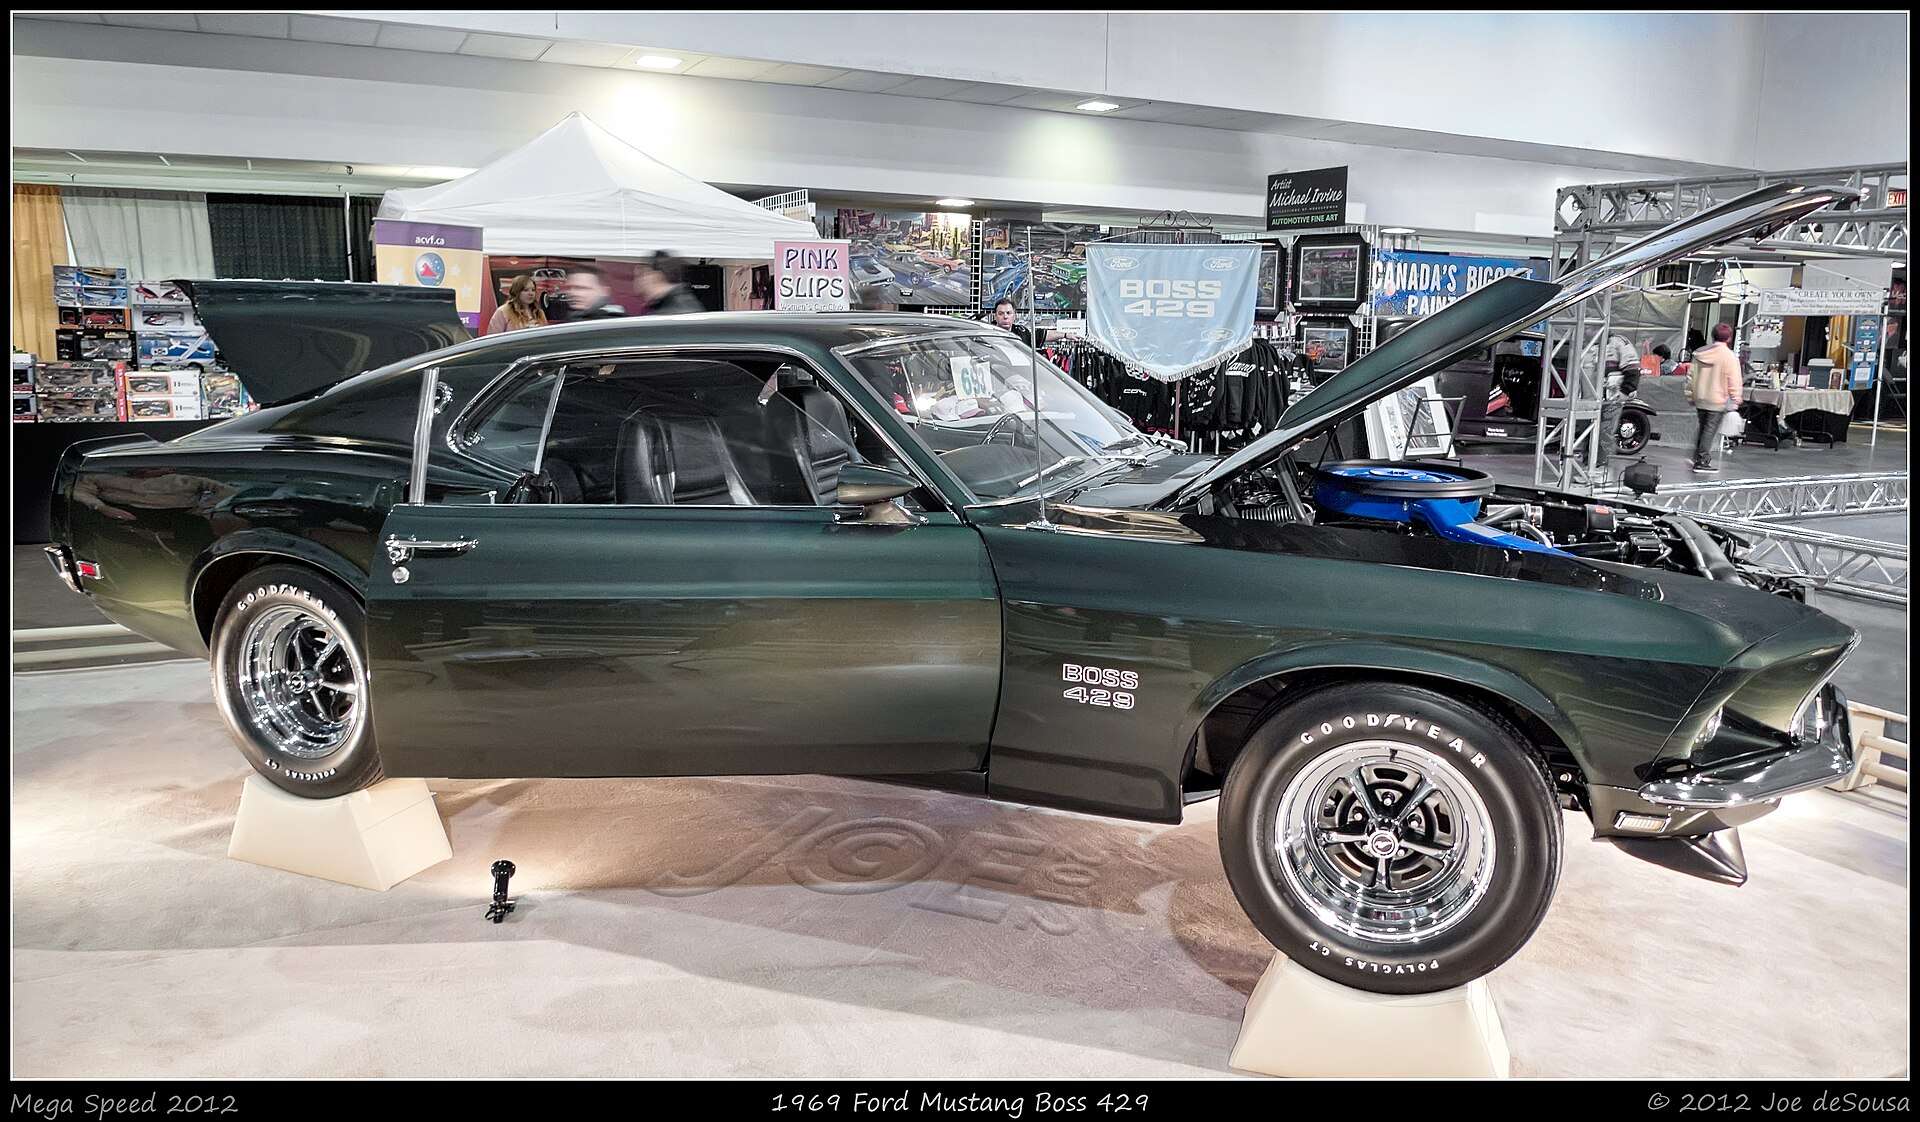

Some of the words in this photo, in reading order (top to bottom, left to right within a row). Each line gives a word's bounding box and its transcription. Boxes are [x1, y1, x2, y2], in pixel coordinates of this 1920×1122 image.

[1270, 178, 1293, 191] Artist
[1269, 187, 1312, 208] Michael
[1311, 188, 1344, 204] Irvine
[1888, 191, 1905, 204] EXIT
[1271, 215, 1310, 226] AUTOMOTIVE
[1311, 214, 1325, 223] FINE
[1325, 213, 1339, 222] ART
[415, 235, 445, 245] acvf.ca
[784, 248, 838, 270] PINK
[1371, 261, 1458, 293] CANADA'S
[1467, 265, 1533, 293] BIGT
[779, 276, 844, 299] SLIPS
[1119, 279, 1222, 300] BOSS
[1124, 299, 1216, 318] 429
[237, 583, 338, 621] GOODYEAR
[1062, 663, 1139, 690] BOSS
[1063, 686, 1135, 709] 429
[1300, 713, 1489, 769] GOODYEAR
[264, 758, 280, 770] GT
[285, 767, 337, 781] POLYGLAS
[1309, 940, 1330, 957] GT
[1345, 956, 1440, 975] POLYGLAS
